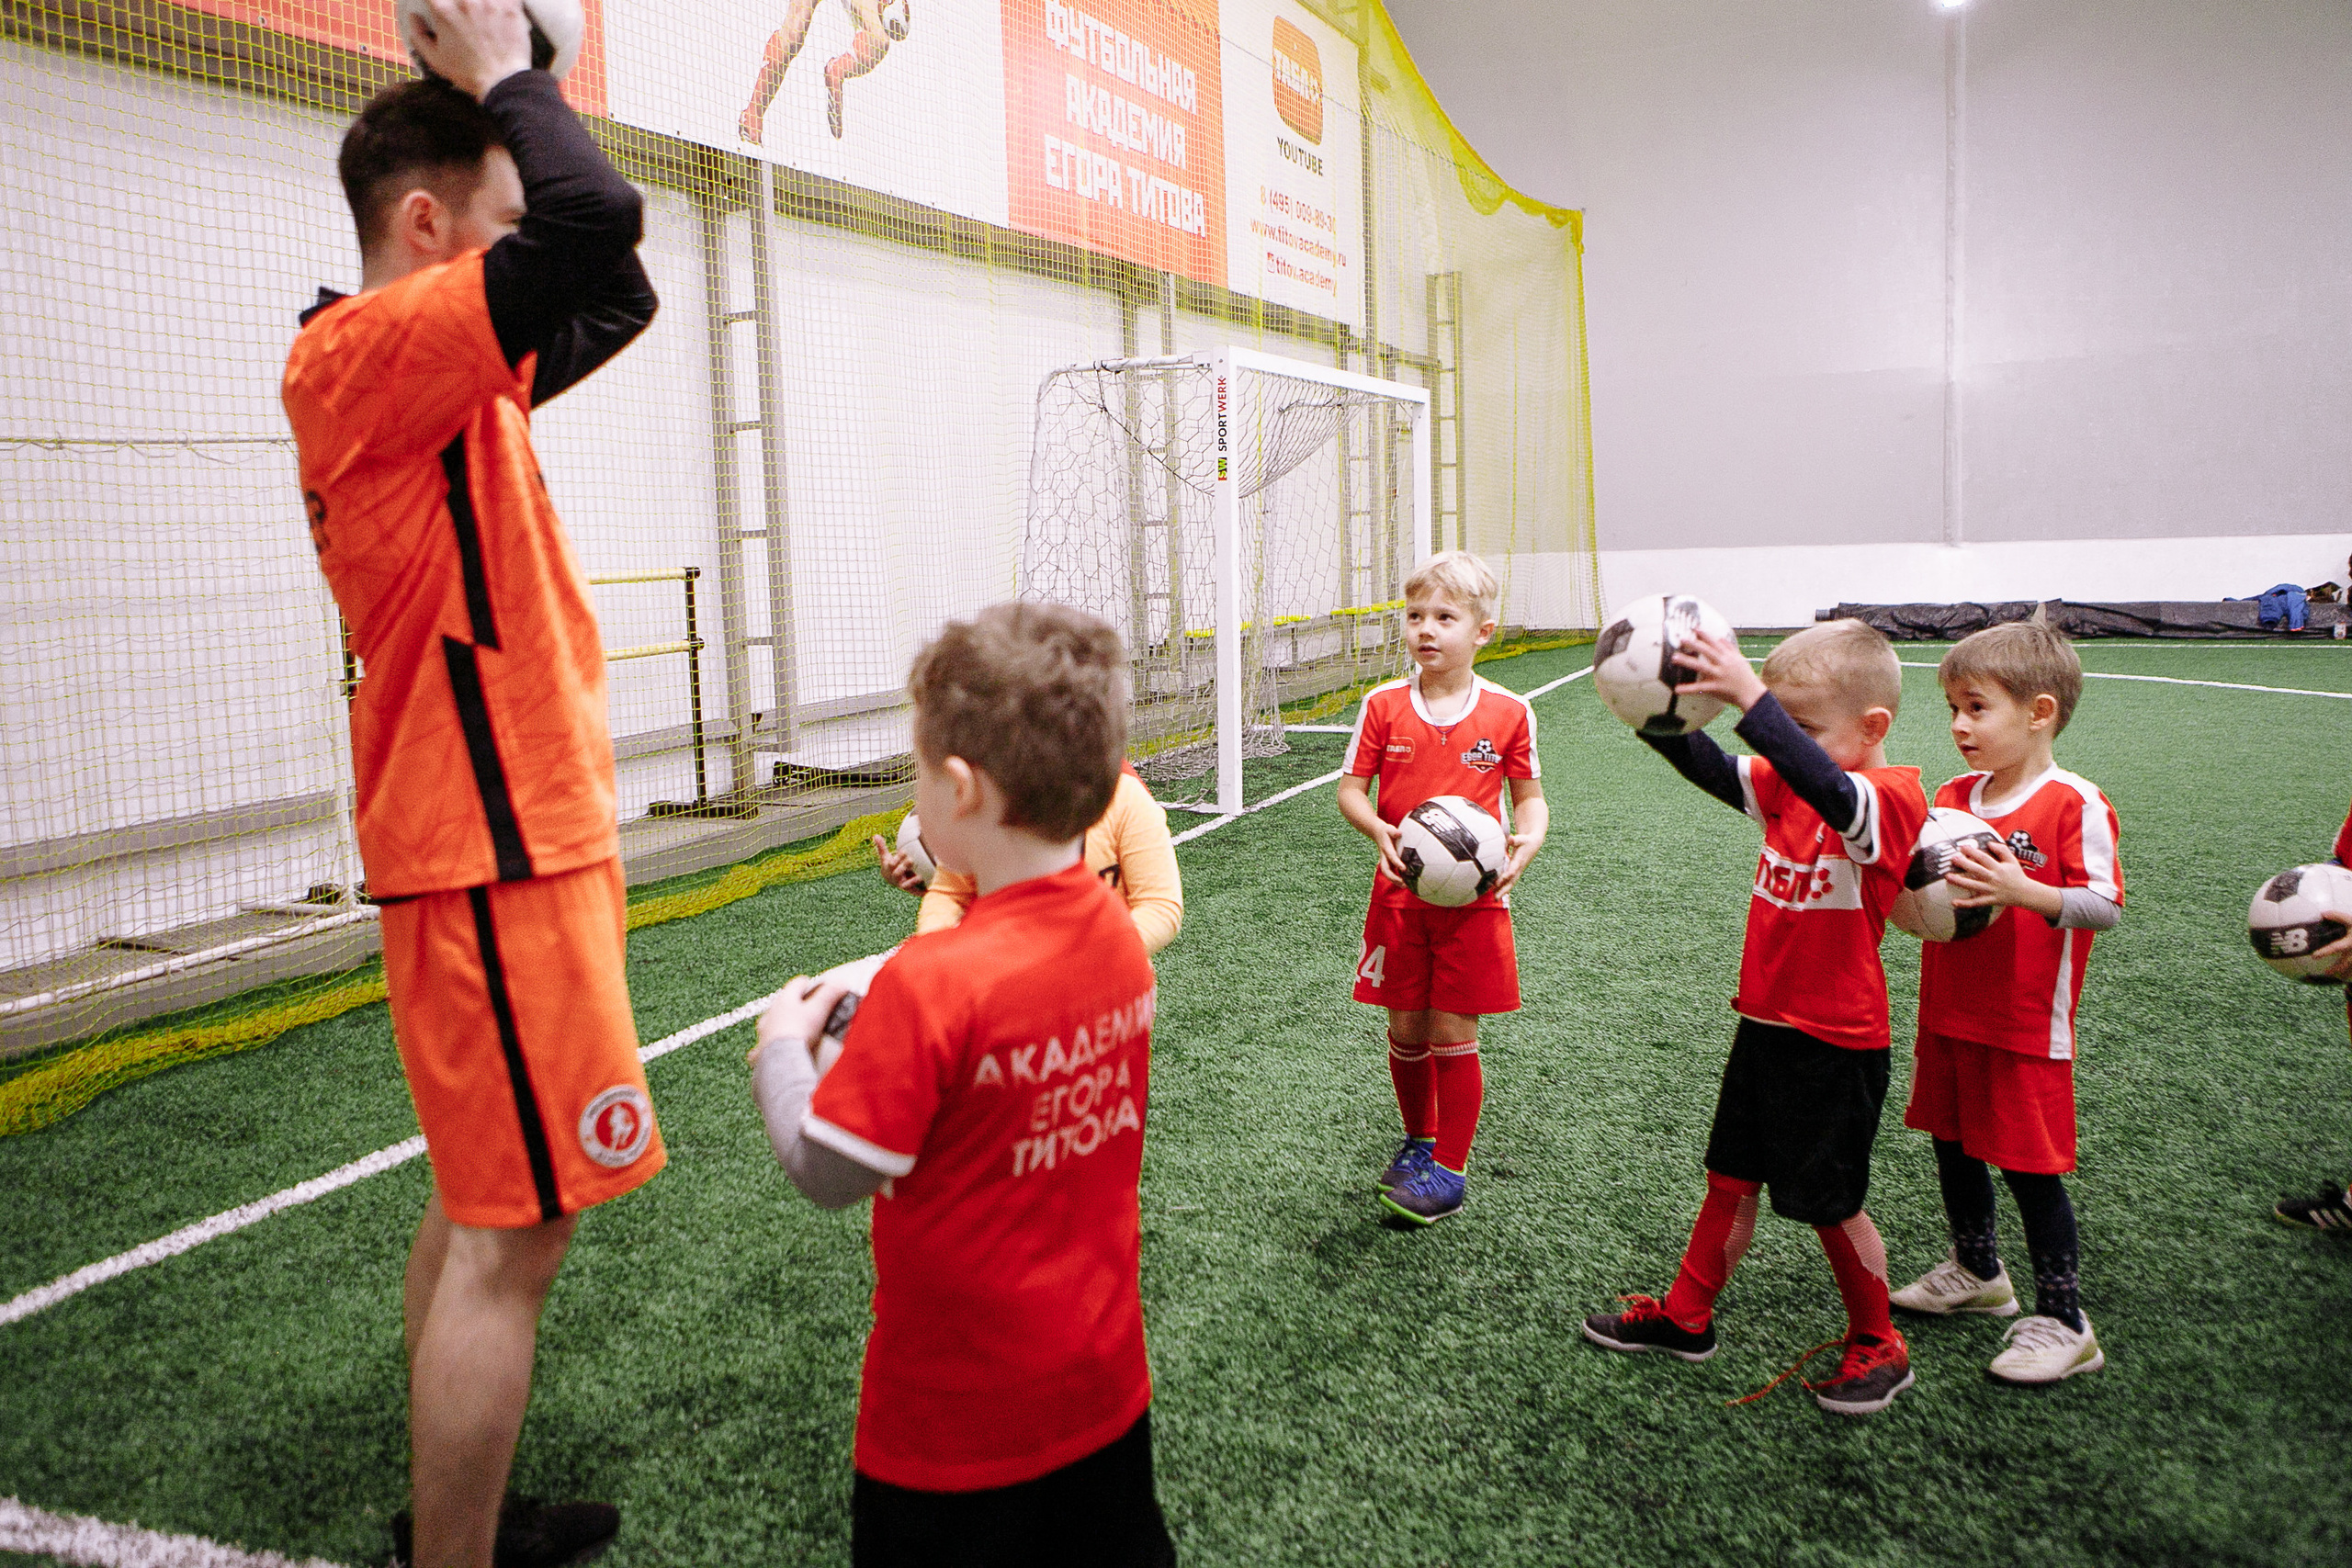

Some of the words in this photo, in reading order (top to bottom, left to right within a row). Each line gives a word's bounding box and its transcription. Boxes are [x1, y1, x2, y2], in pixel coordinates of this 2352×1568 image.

[1046, 0, 1196, 115] ФУТБОЛЬНАЯ
[1066, 73, 1186, 170] АКАДЕМИЯ
[1277, 137, 1323, 176] YOUTUBE
[1045, 134, 1123, 209] ЕГОРА
[1126, 166, 1205, 238] ТИТОВА
[1260, 184, 1267, 207] 8
[1270, 189, 1293, 220] (495)
[1217, 378, 1227, 452] SPORTWERK
